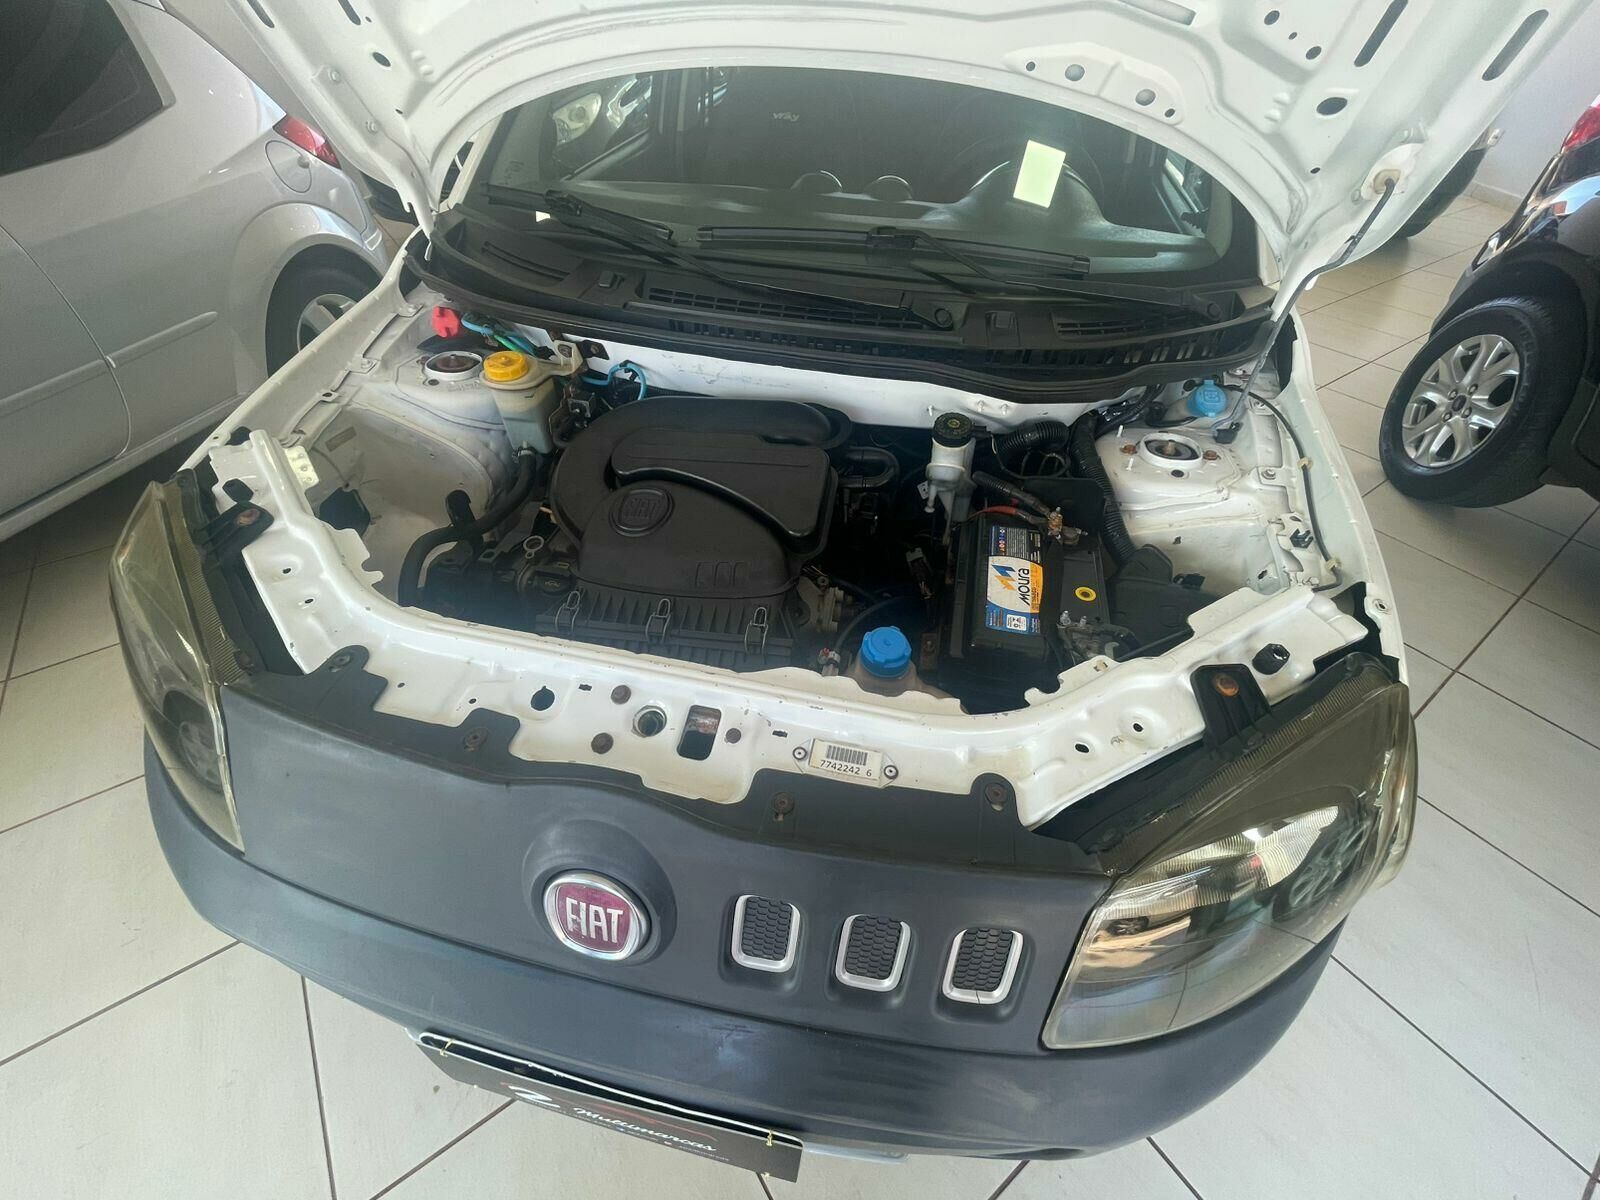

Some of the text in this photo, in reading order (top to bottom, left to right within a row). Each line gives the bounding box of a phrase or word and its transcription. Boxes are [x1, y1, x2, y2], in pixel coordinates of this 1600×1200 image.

[820, 760, 873, 777] 7742242 6
[565, 897, 623, 944] FIAT
